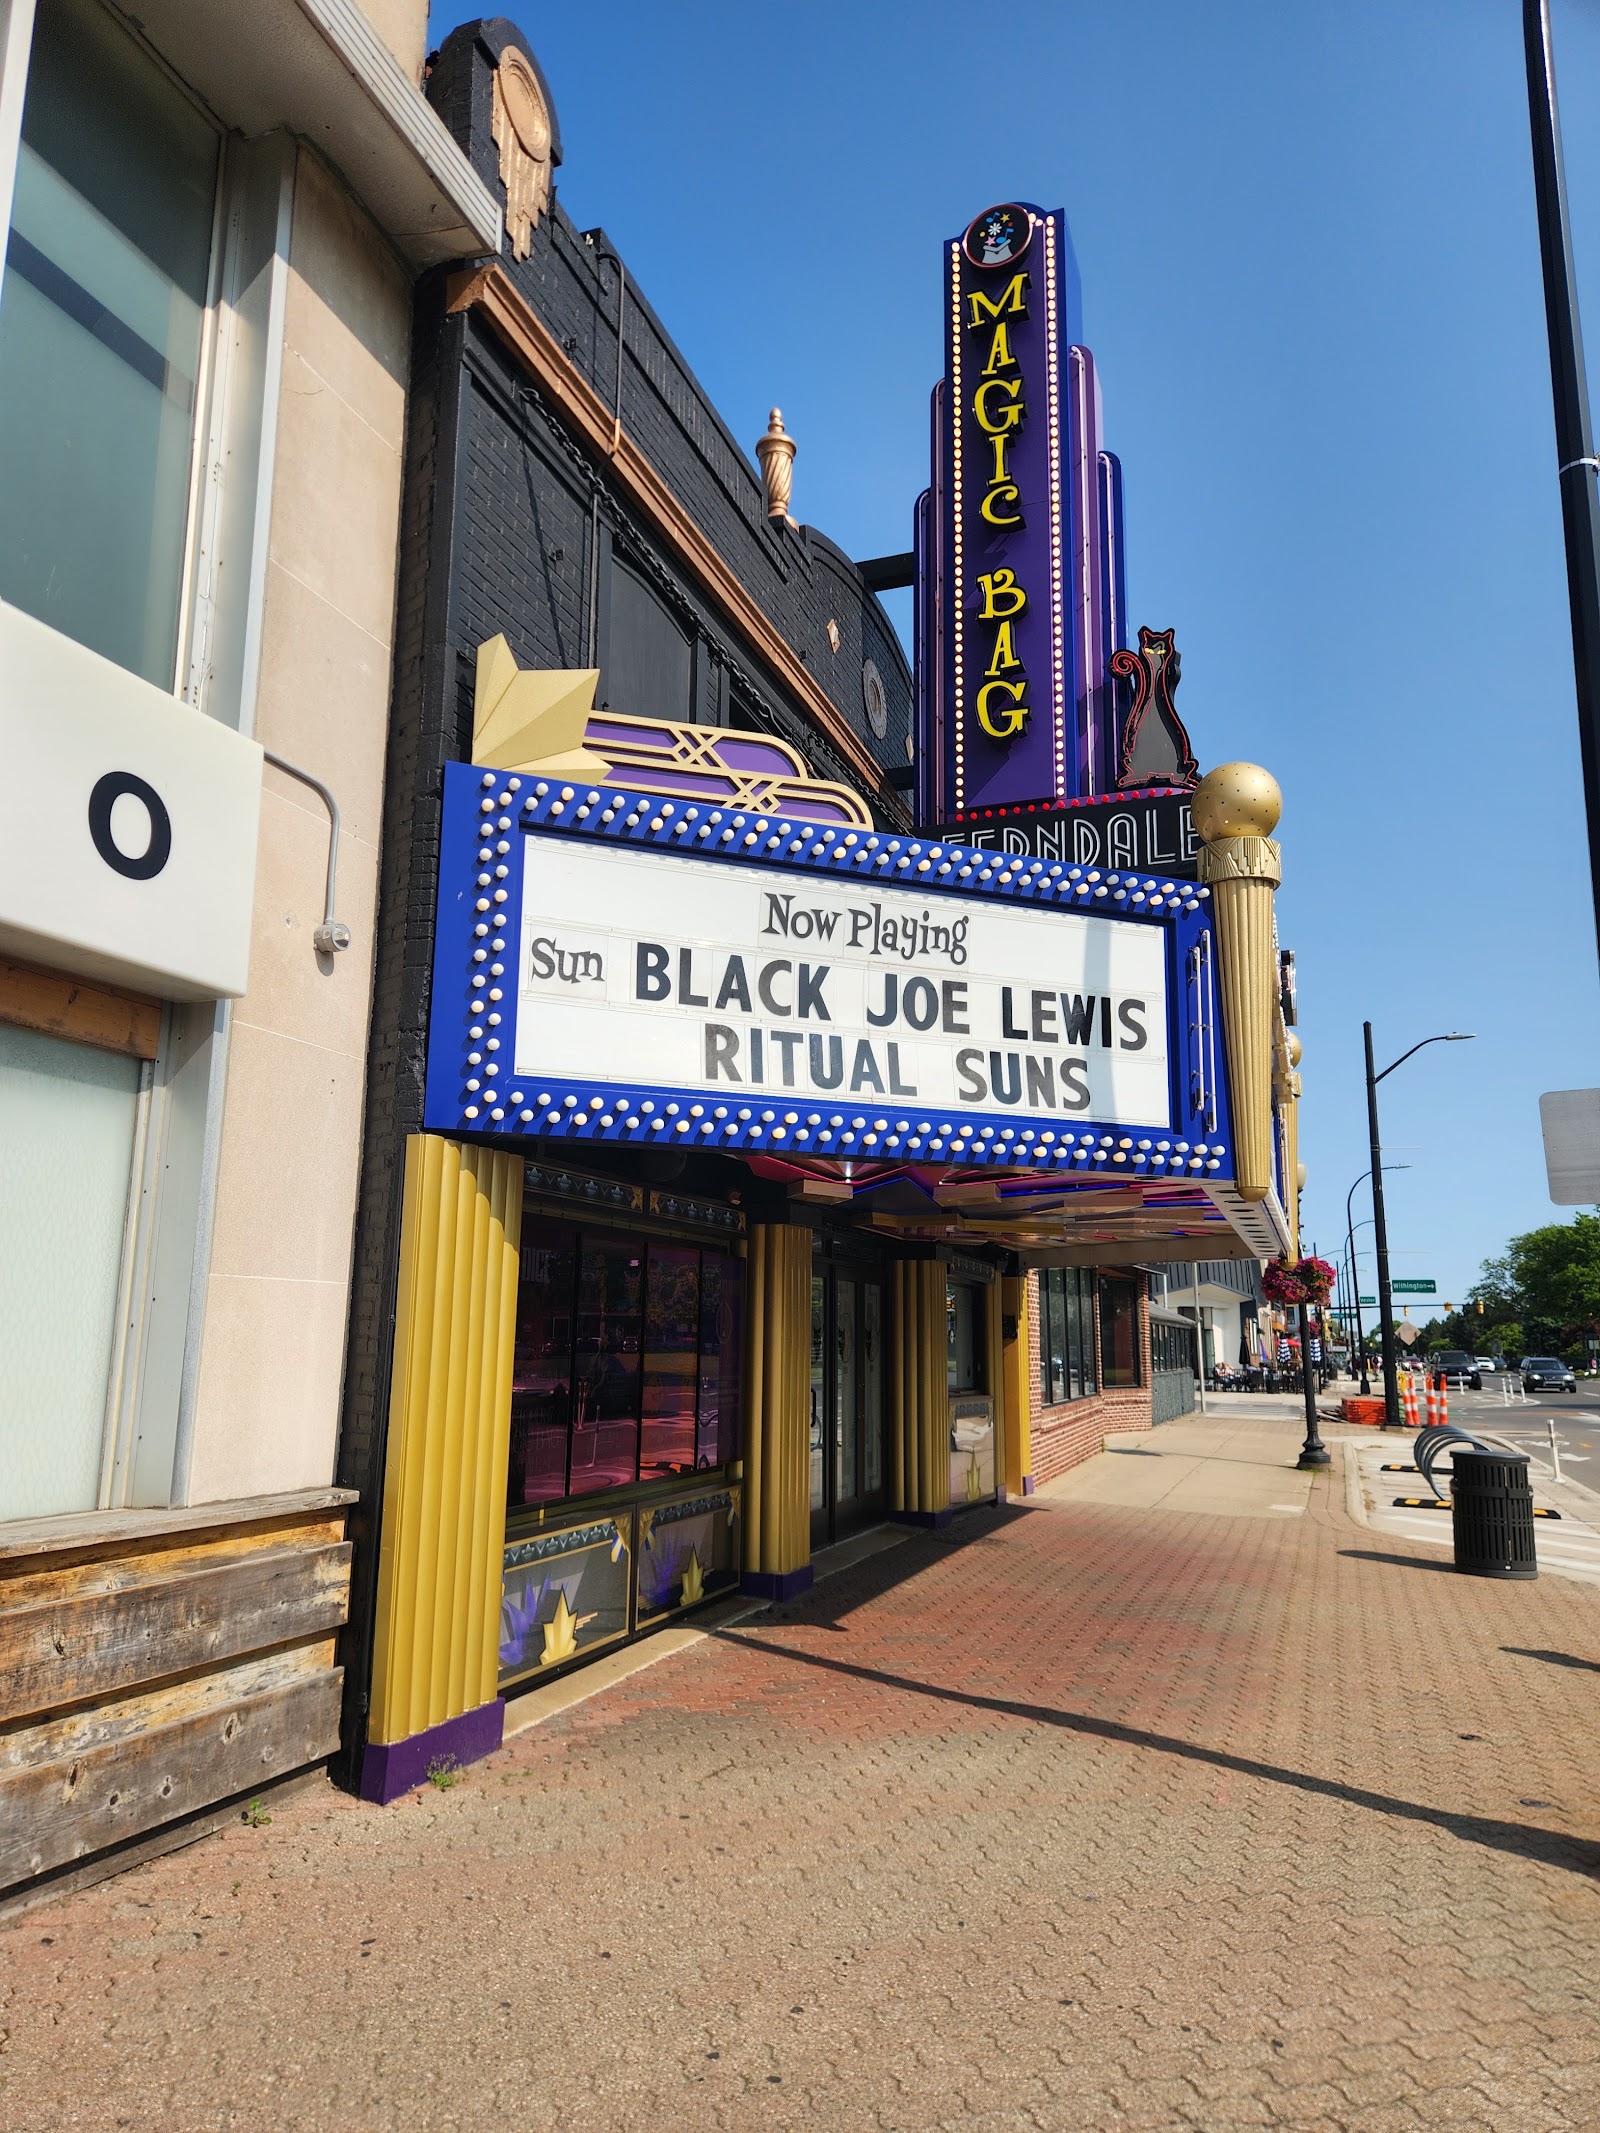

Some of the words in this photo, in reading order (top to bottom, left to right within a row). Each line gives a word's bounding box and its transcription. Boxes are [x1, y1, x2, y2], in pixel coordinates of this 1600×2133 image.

[967, 273, 1027, 525] MAGIC
[976, 568, 1028, 738] BAG
[762, 892, 843, 941] Now
[846, 903, 969, 965] Playing
[531, 937, 604, 984] Sun
[636, 941, 832, 1021] BLACK
[867, 973, 970, 1035] JOE
[1001, 986, 1148, 1051] LEWIS
[705, 1023, 917, 1096] RITUAL
[955, 1048, 1090, 1110] SUNS
[1393, 1282, 1427, 1291] Withington
